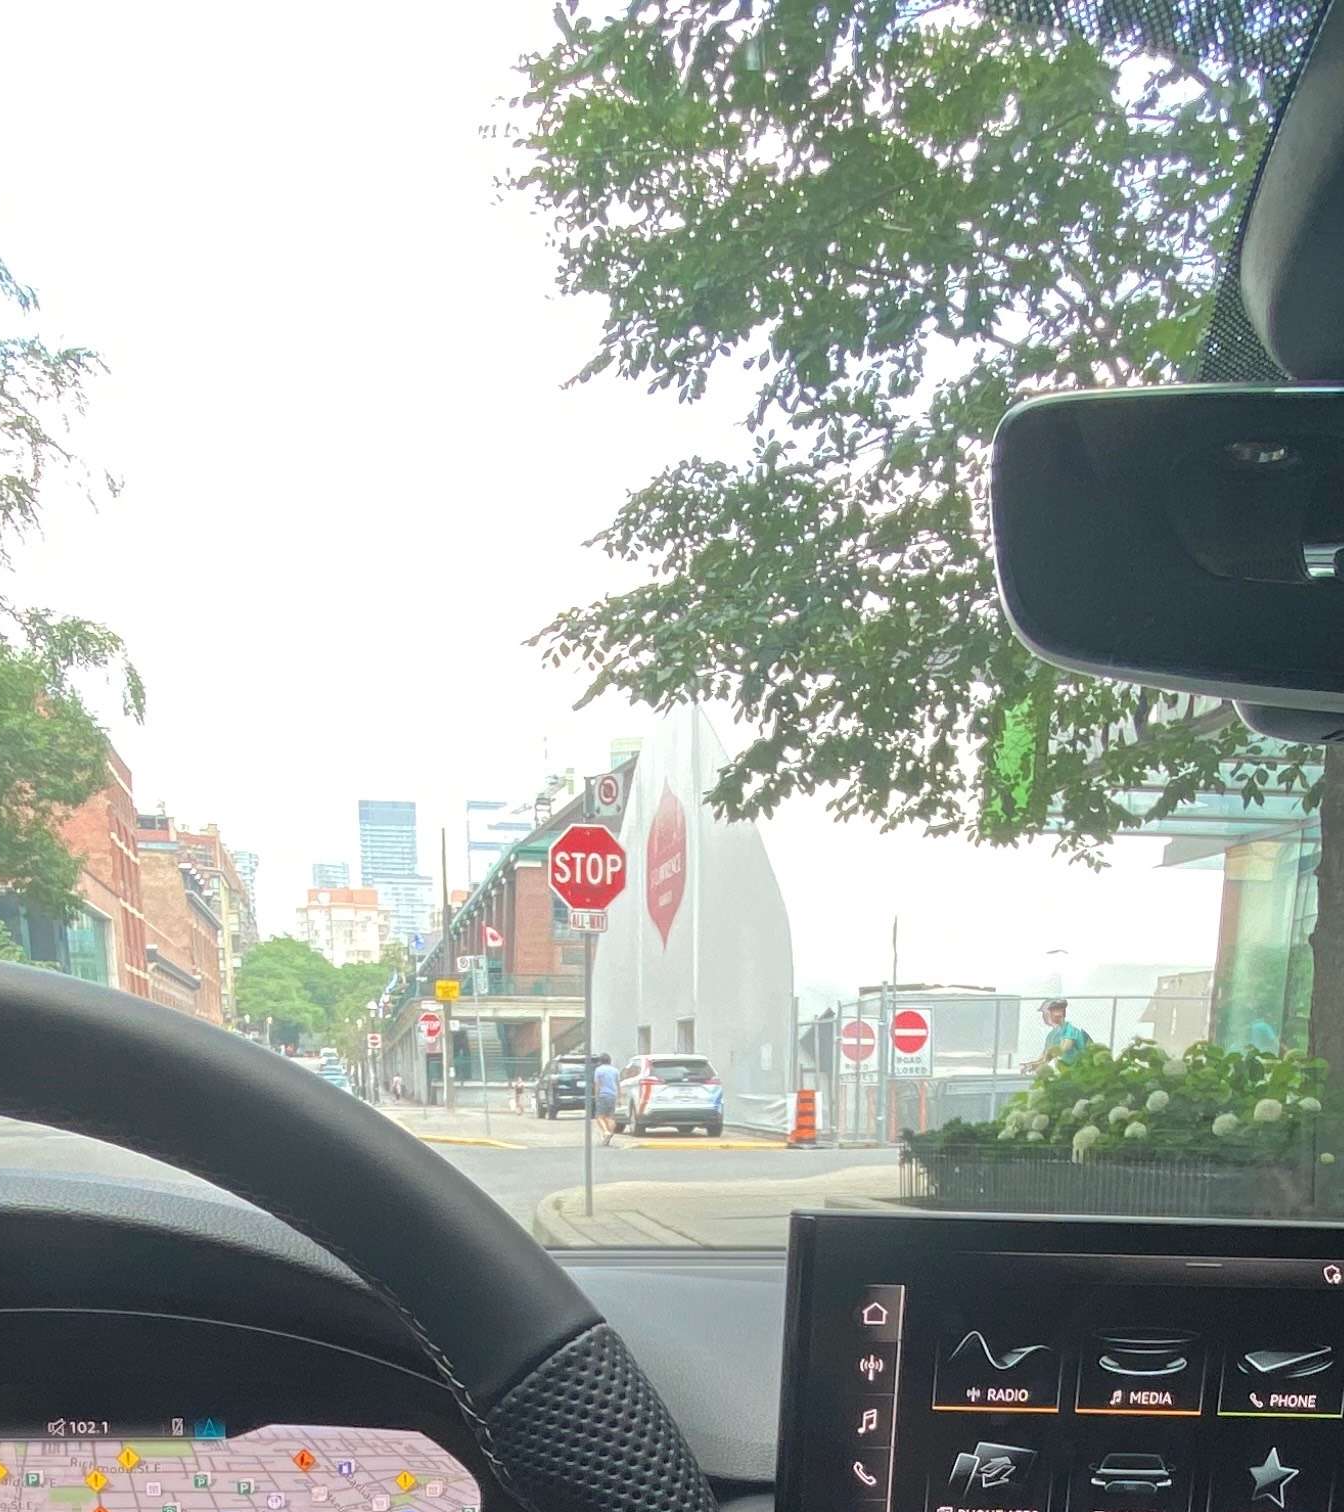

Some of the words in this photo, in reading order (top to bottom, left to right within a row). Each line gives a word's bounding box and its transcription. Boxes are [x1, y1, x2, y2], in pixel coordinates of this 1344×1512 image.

[554, 851, 623, 885] STOP
[987, 1388, 1029, 1402] RADIO
[1130, 1391, 1173, 1405] MEDIA
[1269, 1394, 1317, 1408] PHONE
[69, 1421, 109, 1434] 102.1
